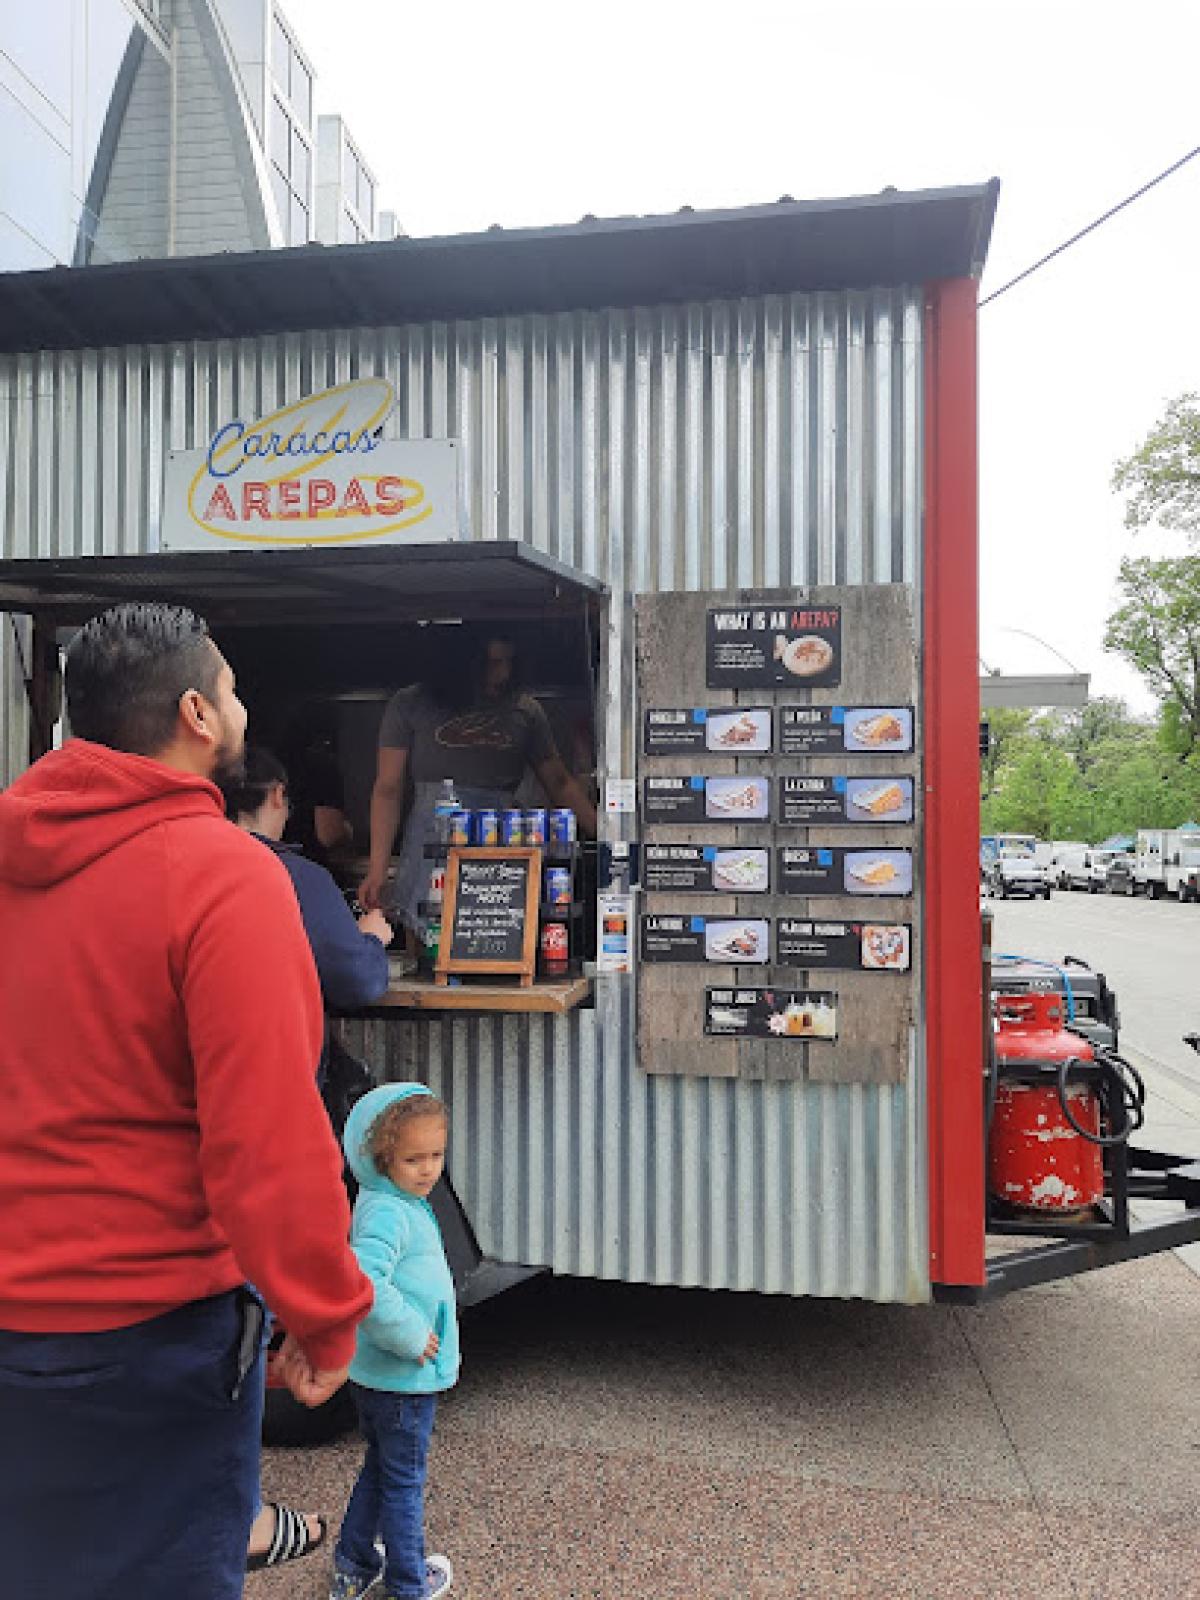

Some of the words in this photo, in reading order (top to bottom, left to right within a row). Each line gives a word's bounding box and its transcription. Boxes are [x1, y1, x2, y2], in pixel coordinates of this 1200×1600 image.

[208, 422, 382, 478] Caracas
[202, 475, 405, 521] AREPAS
[714, 611, 750, 631] WHAT
[752, 611, 766, 631] IS
[770, 611, 787, 631] AN
